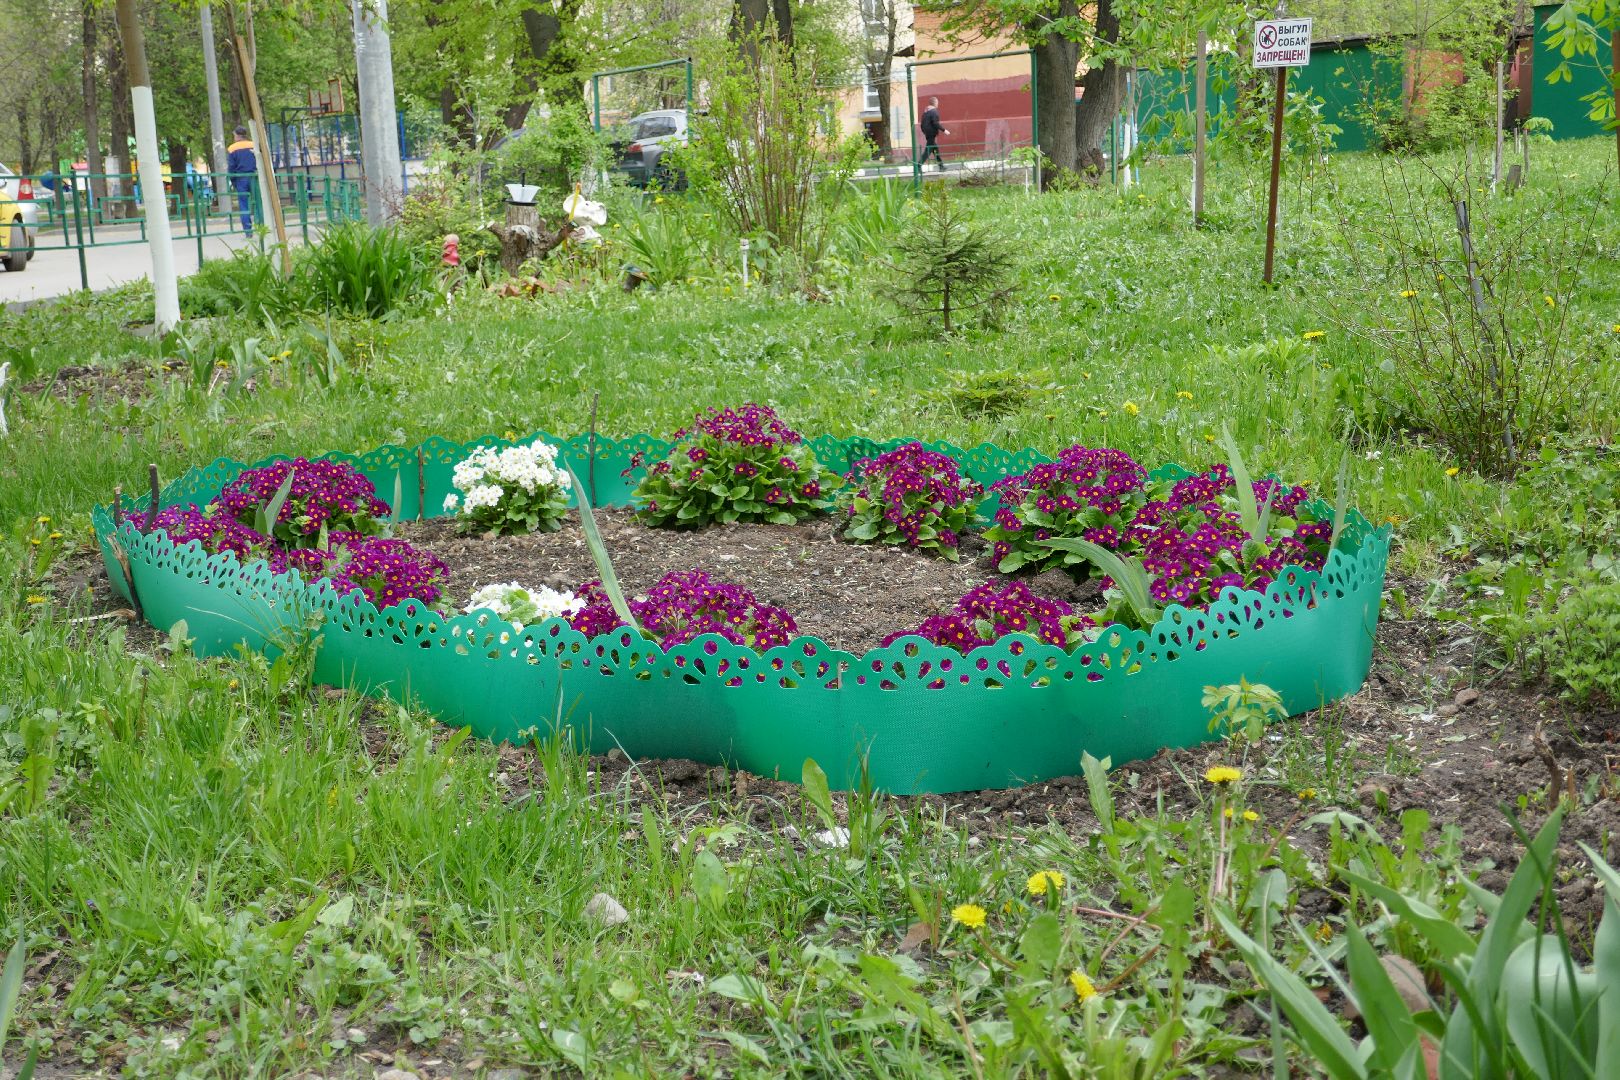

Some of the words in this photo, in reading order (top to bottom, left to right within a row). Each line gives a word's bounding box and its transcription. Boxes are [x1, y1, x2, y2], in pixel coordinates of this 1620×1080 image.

[1279, 25, 1307, 34] ВЫГУЛ
[1278, 37, 1306, 46] СОБАК
[1257, 50, 1306, 62] ЗАПРЕЩЕН!
